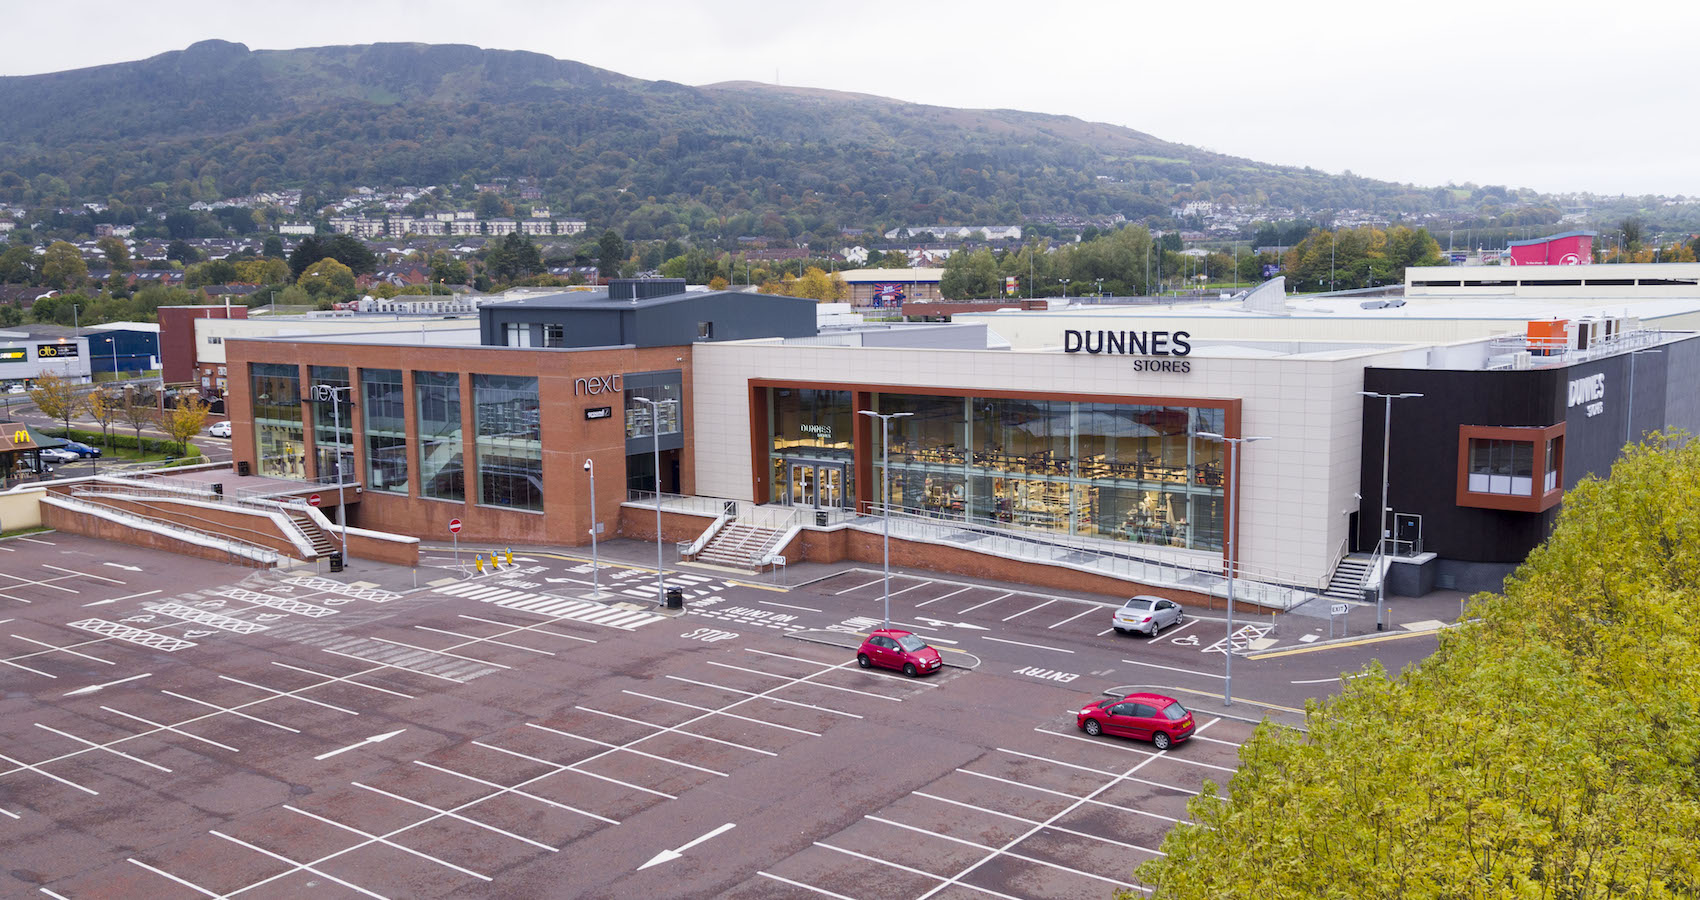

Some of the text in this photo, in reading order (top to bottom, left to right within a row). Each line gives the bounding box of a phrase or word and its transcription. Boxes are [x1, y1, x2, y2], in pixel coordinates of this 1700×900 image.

[1064, 330, 1191, 356] DUNNES
[1133, 360, 1191, 373] STORES
[575, 374, 621, 396] next
[1568, 373, 1605, 407] DUNNES
[801, 424, 831, 434] DUNNES
[719, 606, 798, 622] NO ENTRY
[680, 628, 739, 642] STOP
[1013, 666, 1080, 682] ENTRY
